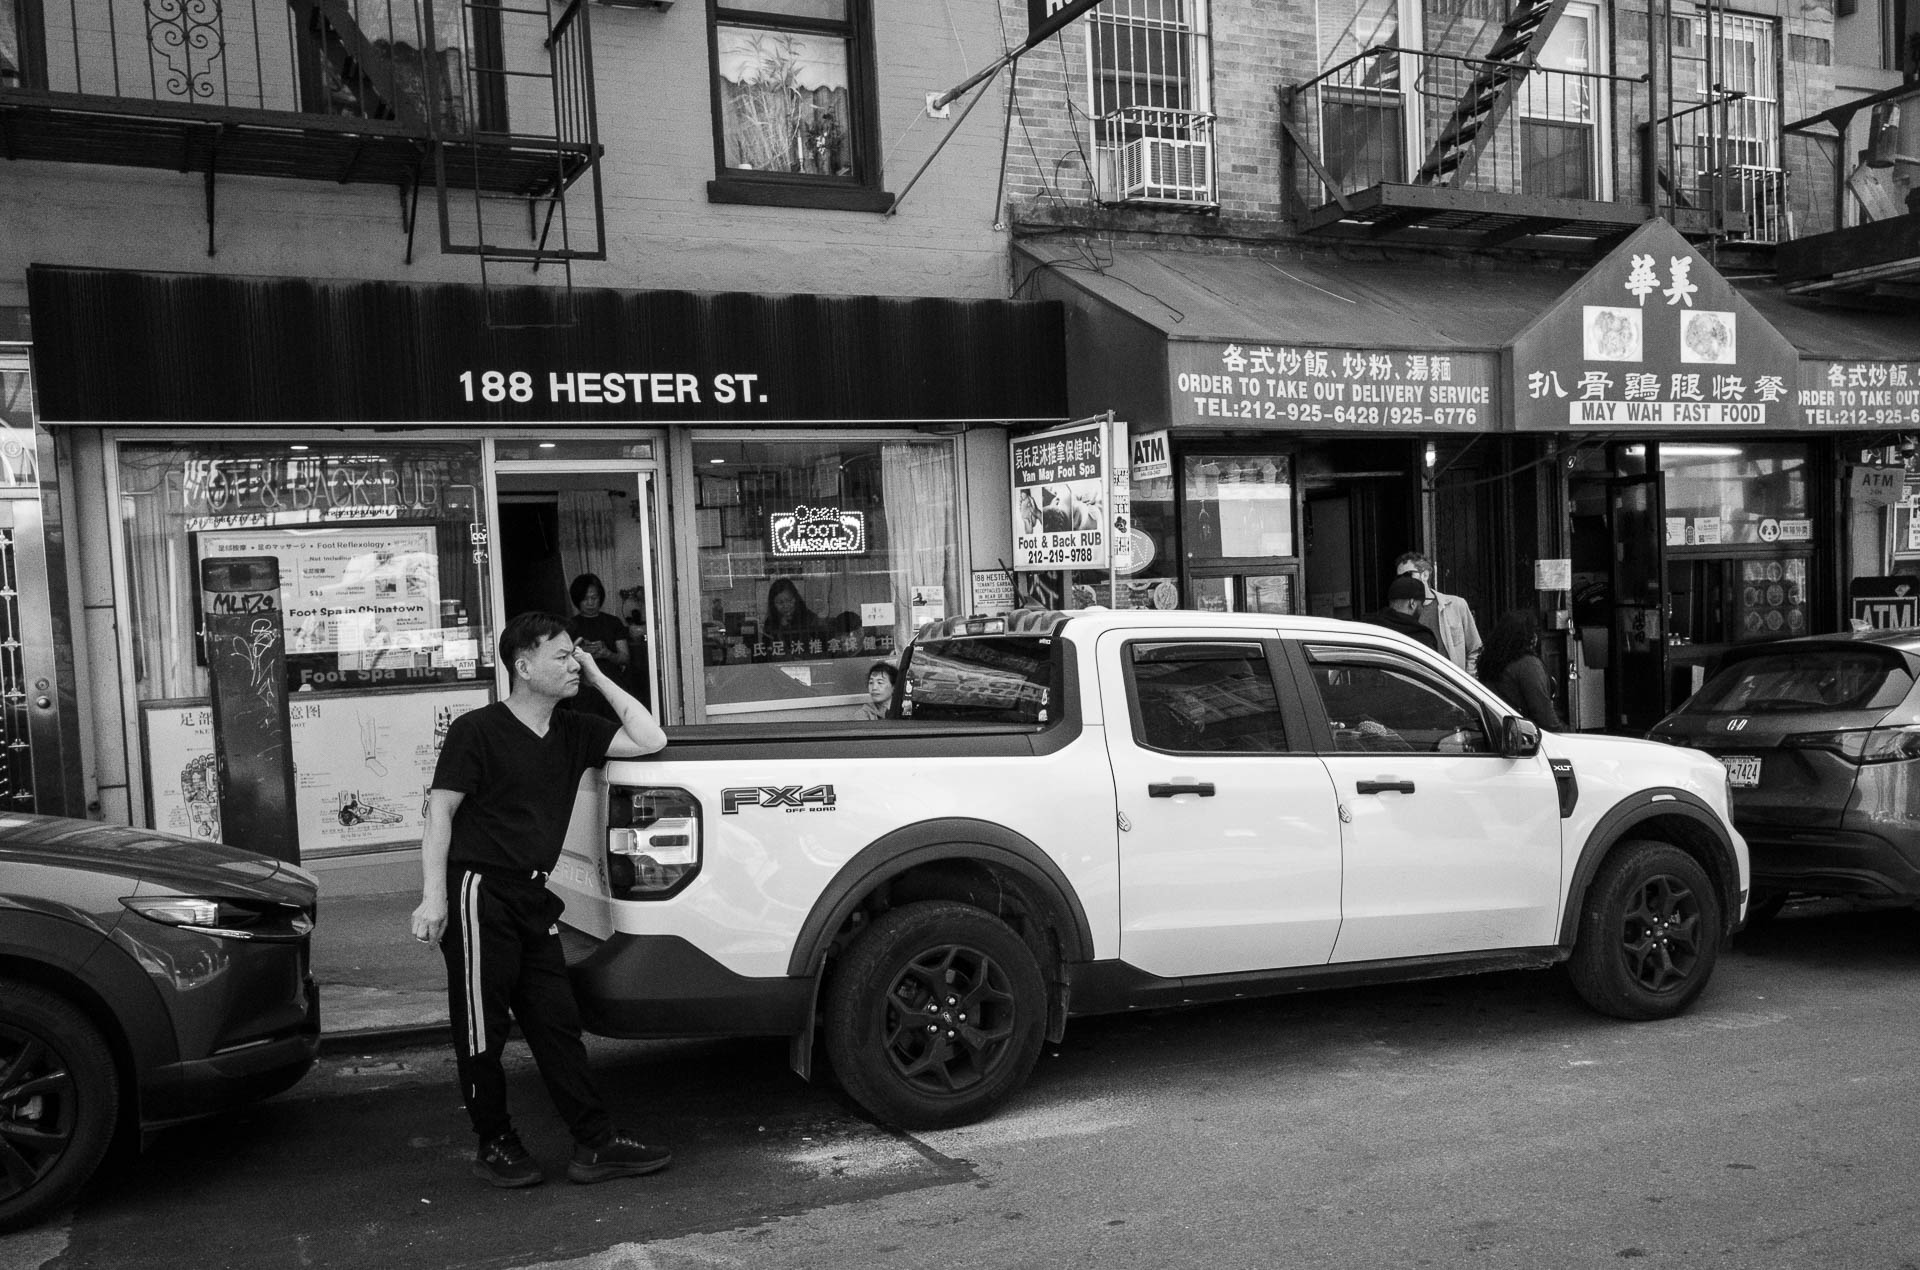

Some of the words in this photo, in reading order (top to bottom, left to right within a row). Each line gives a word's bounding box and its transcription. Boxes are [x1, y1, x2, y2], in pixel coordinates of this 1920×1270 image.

[1828, 363, 1920, 387] 各式炒飯、
[459, 371, 533, 402] 188
[550, 372, 701, 403] HESTER
[714, 373, 768, 403] ST.
[1178, 373, 1232, 394] ORDER
[1239, 377, 1260, 396] TO
[1267, 380, 1308, 399] TAKE
[1314, 382, 1344, 401] OUT
[1352, 384, 1423, 403] DELIVERY
[1429, 386, 1490, 404] SERVICE
[1840, 390, 1855, 406] TO
[1860, 390, 1891, 406] TAKE
[1896, 390, 1920, 405] OUT
[1582, 402, 1616, 421] MAY
[1627, 403, 1662, 422] WAH
[1673, 403, 1710, 422] FAST
[1721, 404, 1760, 422] FOOD
[1015, 436, 1101, 469] 袁氏足沐推拿保健中心
[1133, 437, 1165, 465] ATM
[1022, 471, 1036, 483] Yan
[1039, 467, 1054, 482] May
[1058, 465, 1076, 478] Foot
[1079, 463, 1096, 477] Spa
[1862, 473, 1893, 487] ATM
[260, 469, 281, 508] &
[293, 468, 370, 509] BACK
[382, 468, 437, 506] RUB
[794, 504, 840, 524] Open
[797, 524, 839, 538] FOOT
[1018, 536, 1037, 549] Foot
[1041, 535, 1048, 548] &
[1052, 534, 1076, 548] Back
[1080, 532, 1101, 546] RUB
[337, 540, 385, 550] Reflexology
[789, 537, 847, 552] MASSAGE
[1028, 548, 1092, 564] 212-219-9788
[289, 608, 317, 617] Foot
[320, 607, 342, 617] Spa
[345, 606, 356, 614] in
[358, 604, 424, 615] Chinatown
[1863, 604, 1911, 629] ATM
[458, 660, 474, 668] ATM
[301, 668, 347, 684] Foot
[358, 668, 396, 683] Spa
[721, 784, 837, 815] FX4
